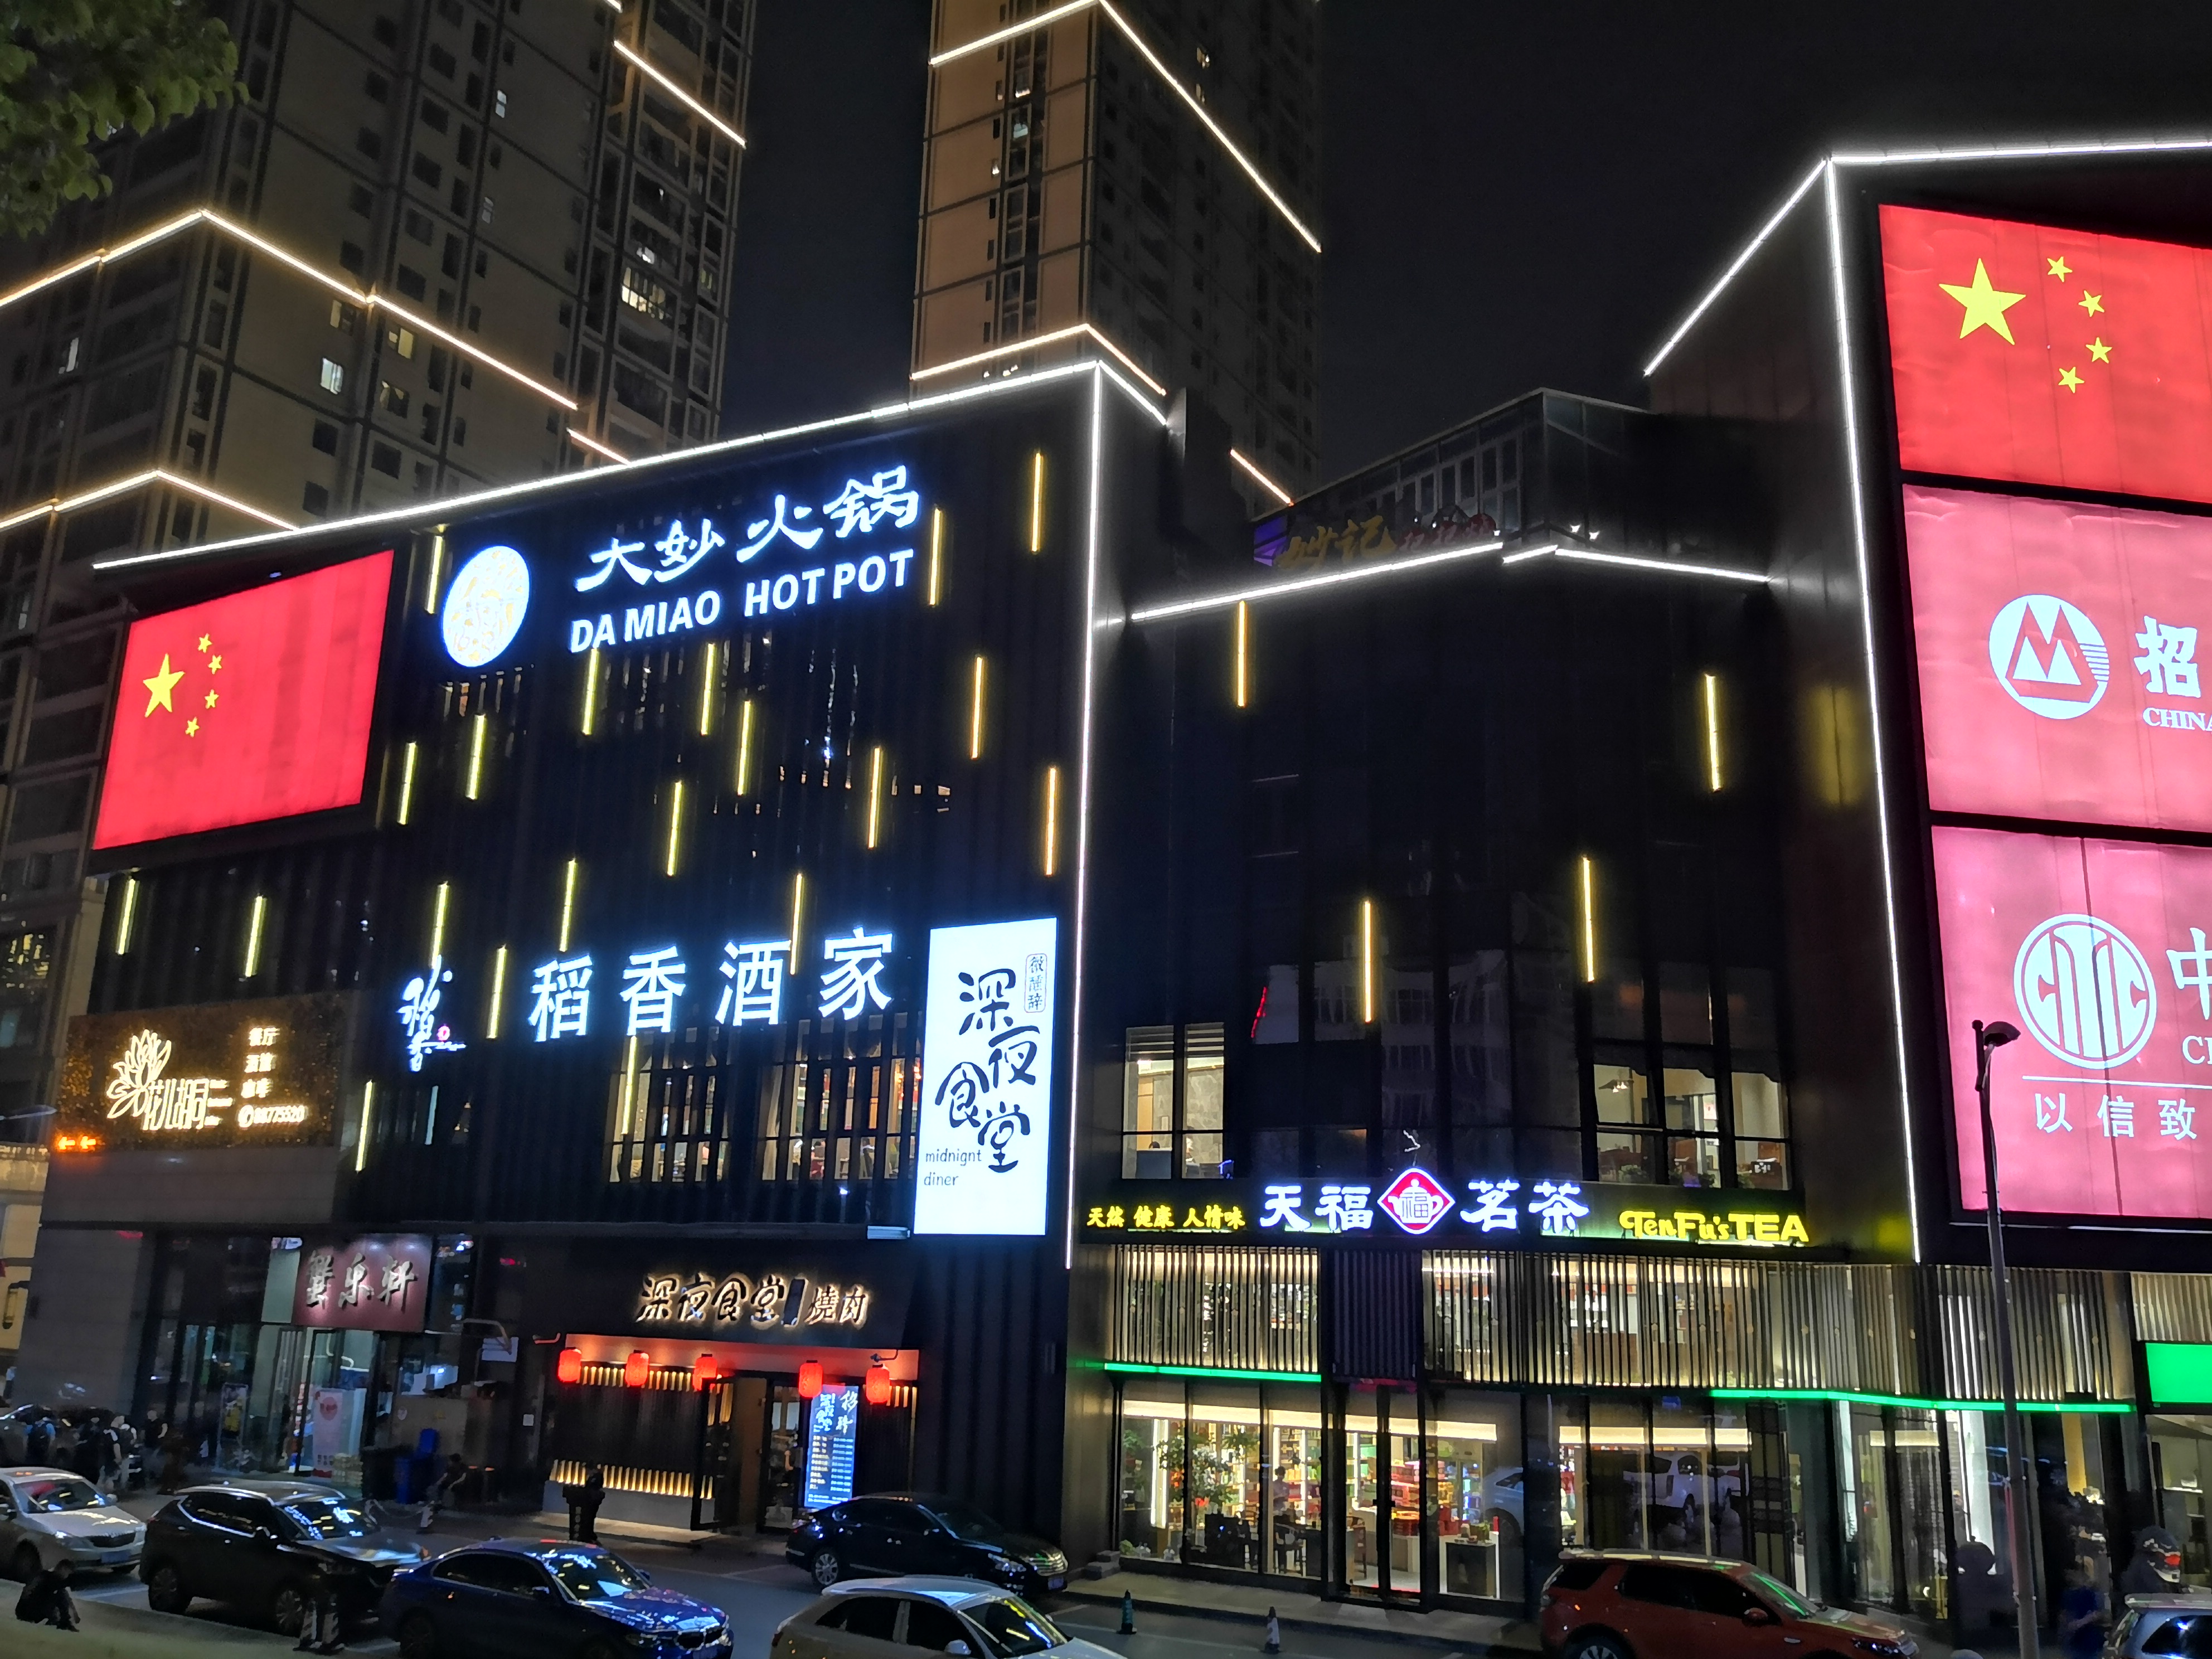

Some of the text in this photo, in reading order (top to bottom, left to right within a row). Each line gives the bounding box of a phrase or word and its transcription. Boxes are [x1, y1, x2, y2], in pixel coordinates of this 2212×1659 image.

[574, 465, 920, 592] 大妙火锅
[570, 549, 914, 653] DA MIAO HOT POT
[2133, 615, 2201, 698] 招
[528, 926, 895, 1042] 稻香酒家
[935, 968, 1040, 1173] 深夜食堂
[2034, 1093, 2198, 1141] 以信致
[924, 1172, 959, 1186] diner
[1259, 1184, 1374, 1233] 天福
[1459, 1179, 1590, 1234] 茗茶
[1086, 1204, 1246, 1229] 天然 健康 人情味
[636, 1272, 786, 1330] 深夜食堂
